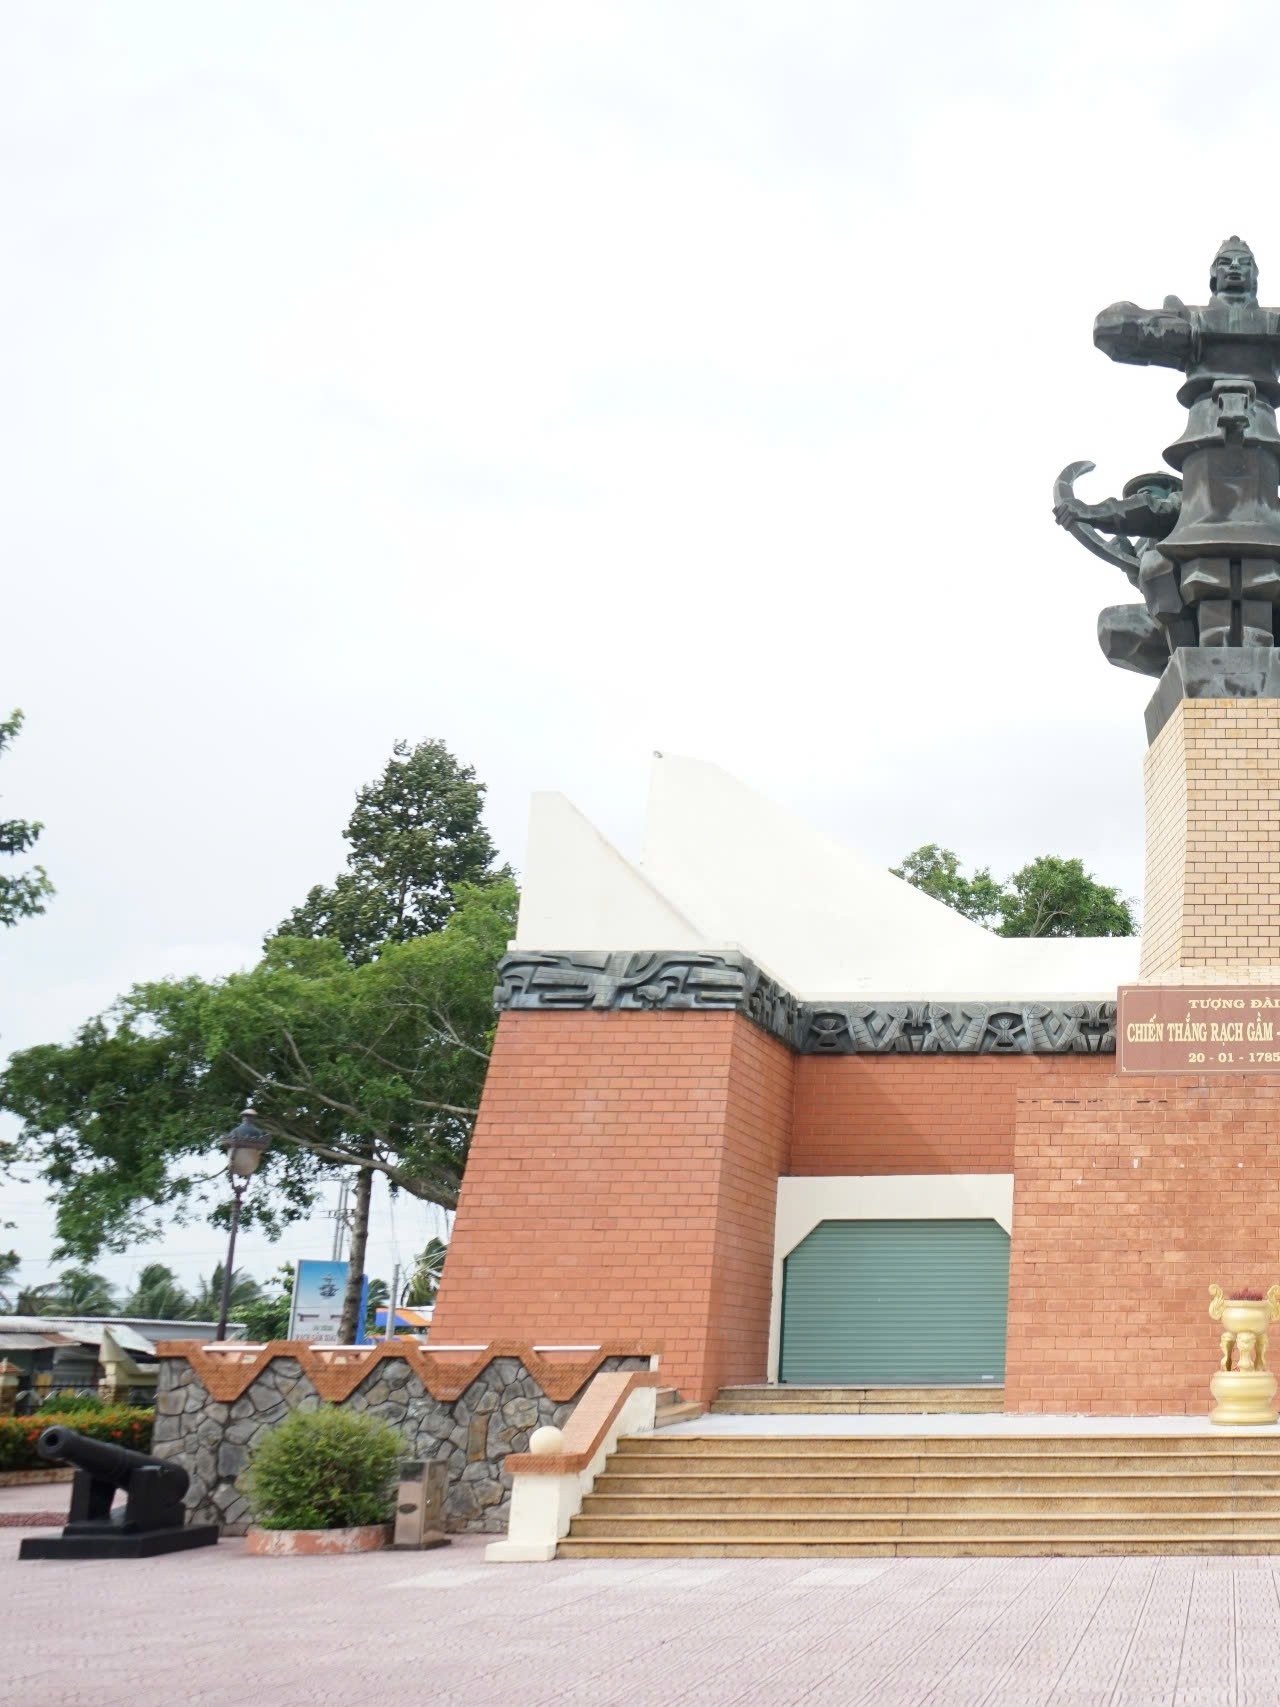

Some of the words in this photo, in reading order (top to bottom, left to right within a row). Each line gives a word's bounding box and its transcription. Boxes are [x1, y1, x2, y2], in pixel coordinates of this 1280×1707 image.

[1188, 997, 1245, 1011] TƯỢNG
[1250, 996, 1280, 1009] ĐÀI
[1127, 1014, 1164, 1042] CHIẾN
[1167, 1012, 1208, 1042] THẮNG
[1210, 1022, 1243, 1046] RẠCH
[1246, 1012, 1274, 1041] GẦM
[1188, 1052, 1206, 1063] 20
[1218, 1052, 1235, 1063] 01
[1248, 1052, 1280, 1063] 1785
